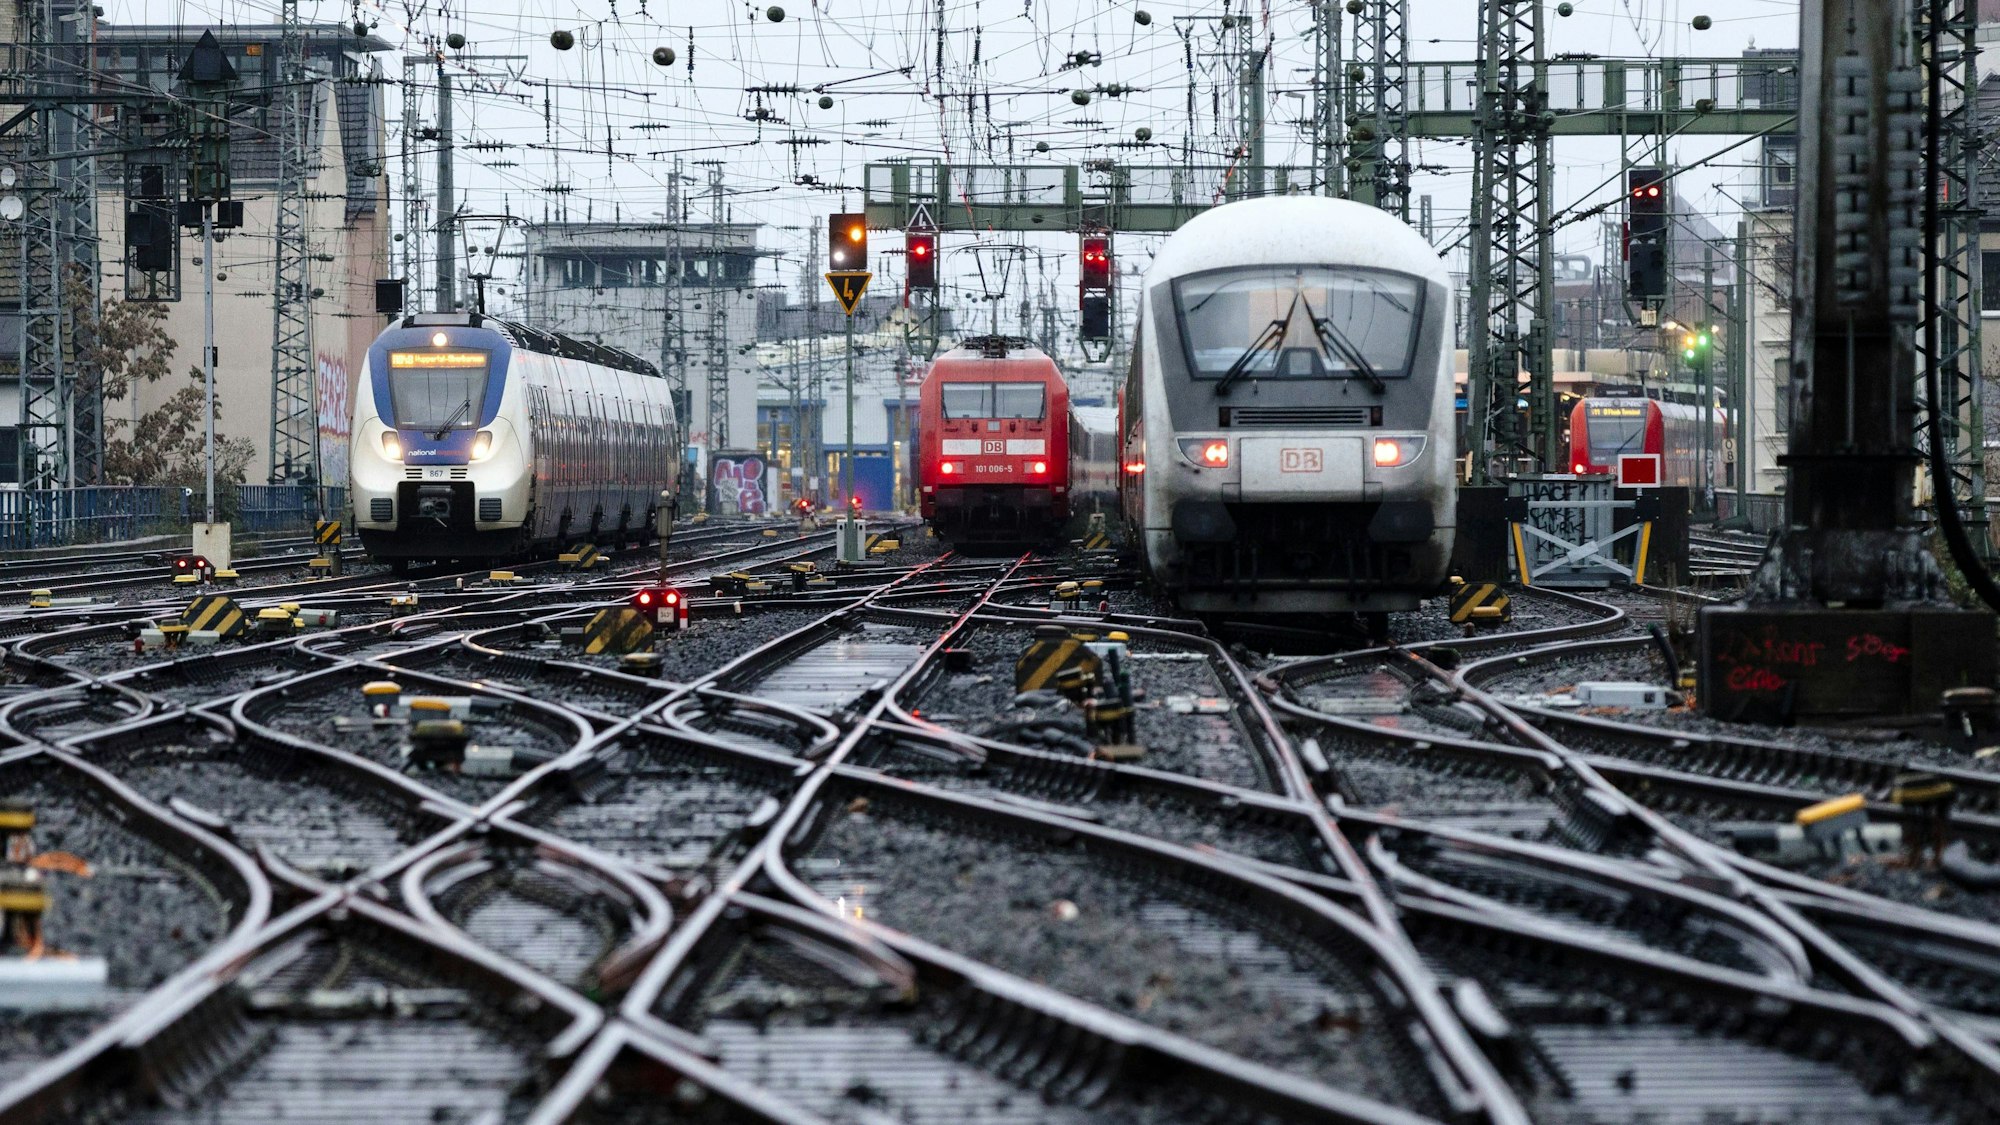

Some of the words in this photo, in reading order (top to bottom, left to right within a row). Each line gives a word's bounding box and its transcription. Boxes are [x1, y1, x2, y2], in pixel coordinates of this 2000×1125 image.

[919, 213, 927, 229] 4
[844, 278, 854, 300] 4
[985, 442, 1002, 452] DB
[1285, 452, 1319, 468] DB
[429, 470, 443, 478] 867
[975, 465, 987, 473] 101
[988, 465, 1013, 473] 006-5
